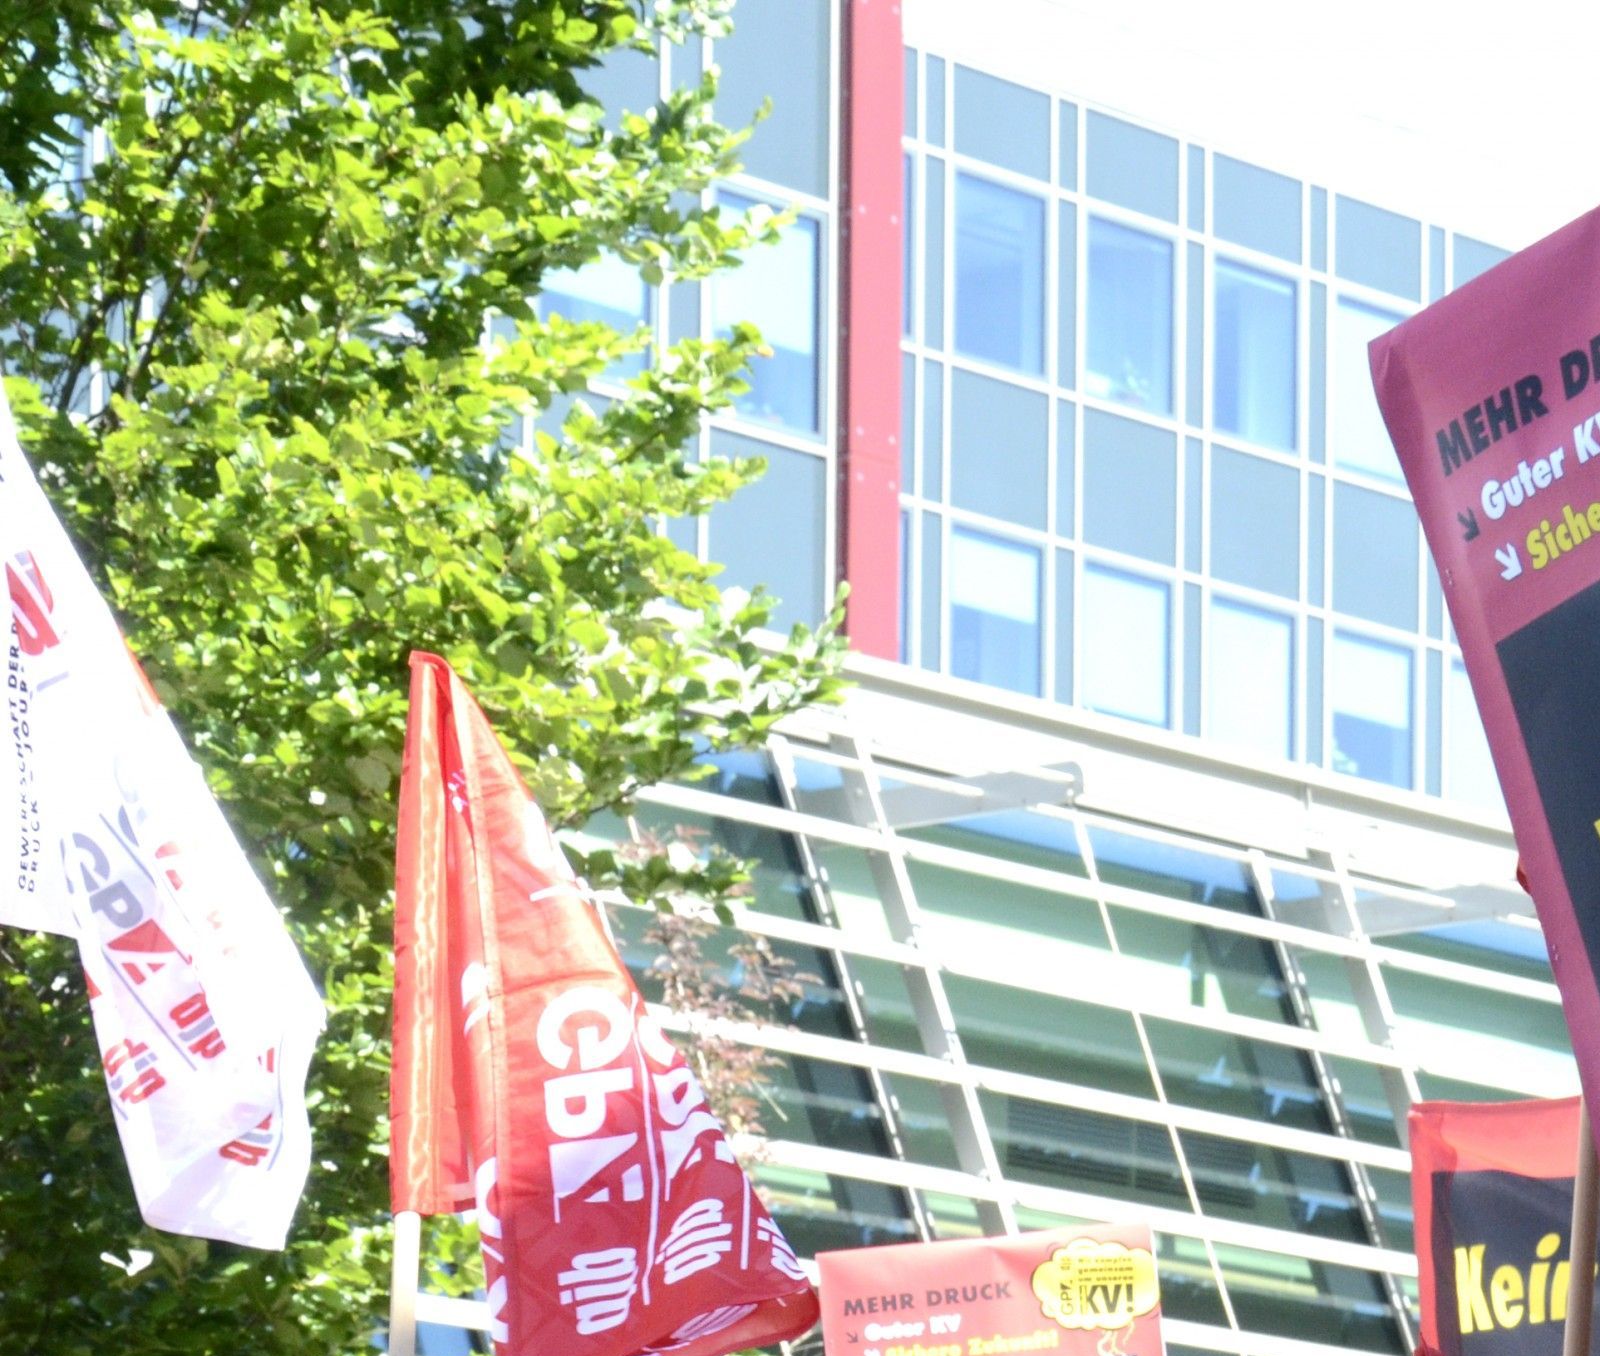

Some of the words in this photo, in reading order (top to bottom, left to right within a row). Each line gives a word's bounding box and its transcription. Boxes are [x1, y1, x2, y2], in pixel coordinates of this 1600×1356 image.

[1436, 373, 1550, 478] MEHR
[1481, 446, 1566, 520] Guter
[844, 1293, 915, 1317] MEHR
[926, 1283, 1013, 1307] DRUCK
[1080, 1284, 1135, 1314] KV!
